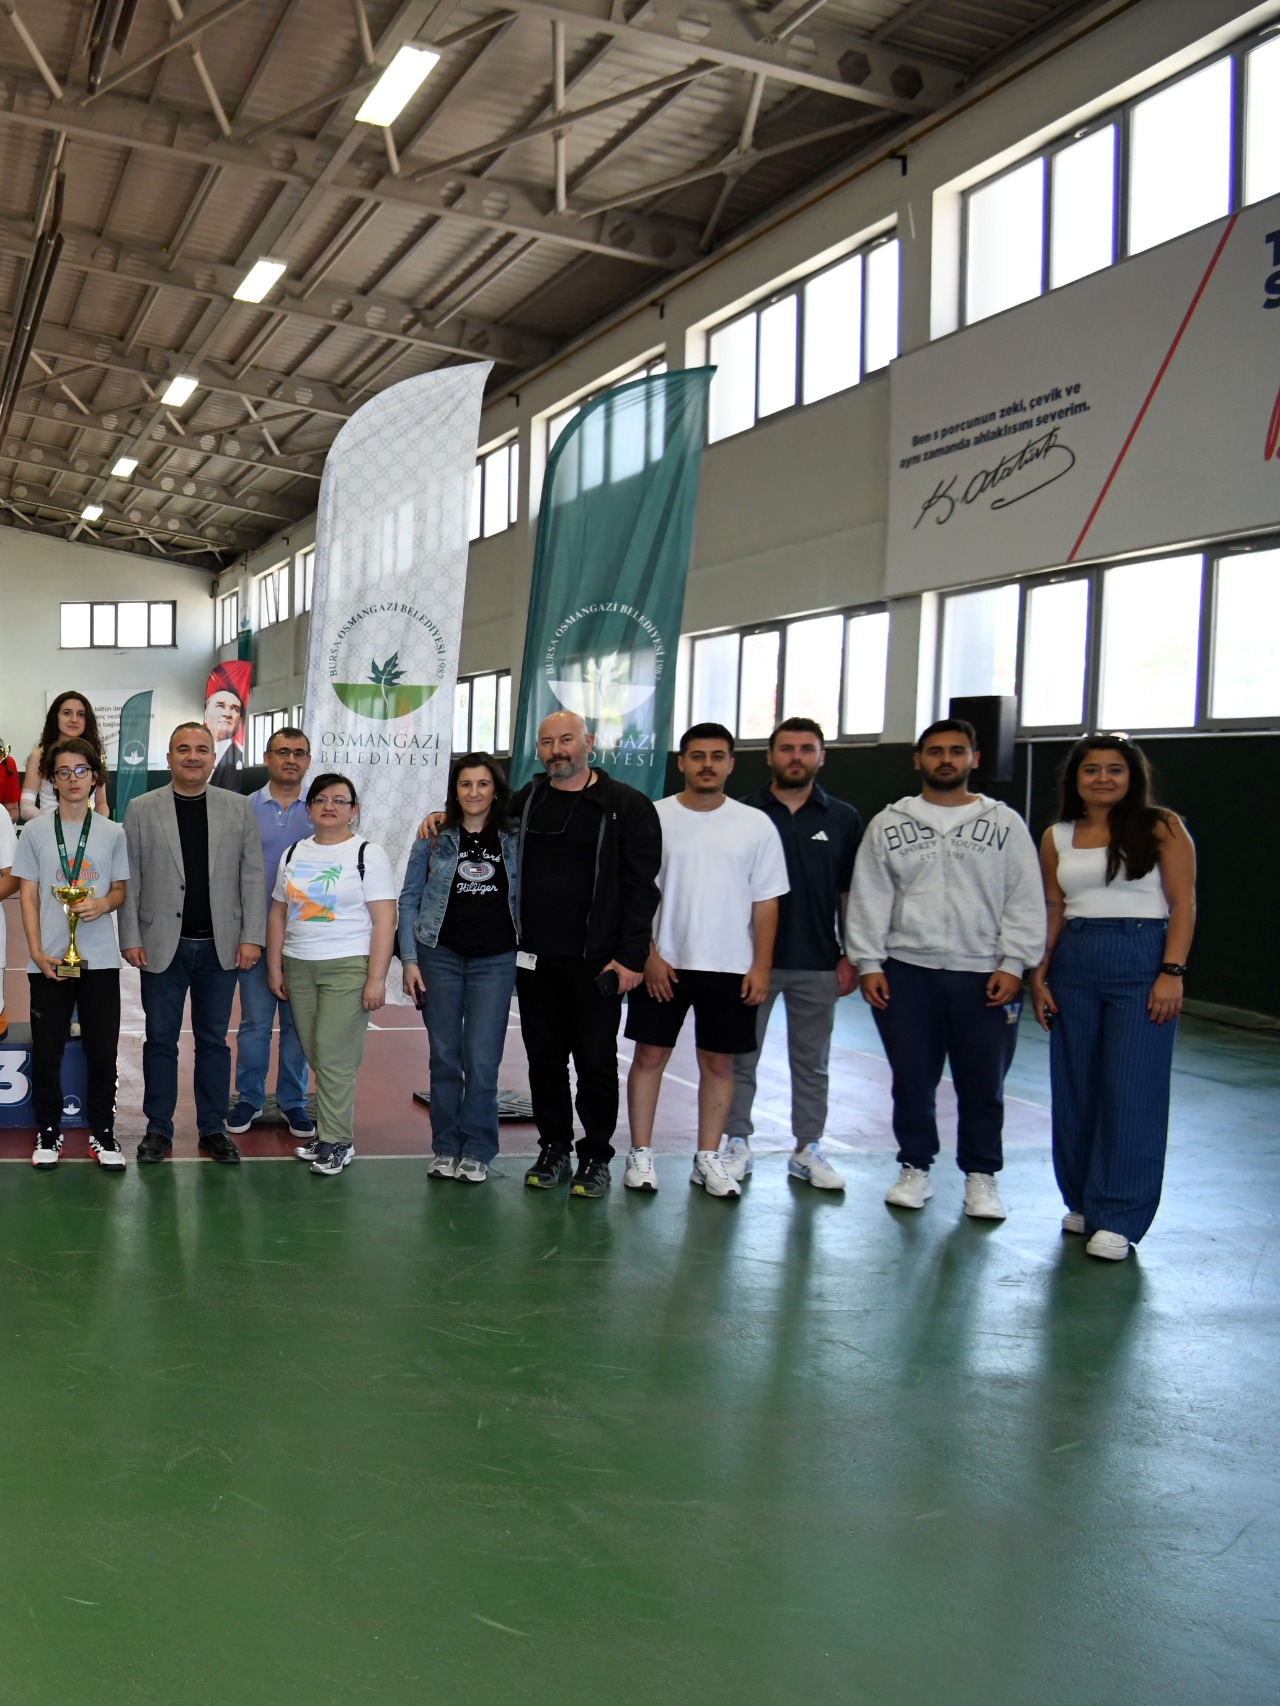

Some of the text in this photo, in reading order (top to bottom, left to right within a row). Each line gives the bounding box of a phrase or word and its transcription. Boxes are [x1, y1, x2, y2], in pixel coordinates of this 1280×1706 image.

[999, 399, 1027, 419] zeki,
[1029, 387, 1062, 411] çevik
[1065, 383, 1081, 397] ve
[1035, 401, 1091, 427] severim.
[328, 601, 447, 680] BURSA OSMANGAZİ BELEDİYESİ 1987
[545, 639, 559, 675] BURSA
[555, 601, 618, 638] OSMANGAZİ
[619, 604, 666, 656] BELEDİYESİ
[321, 731, 440, 750] OSMANGAZİ
[320, 751, 439, 767] BELEDİYESİ
[456, 881, 499, 895] Hilfiger
